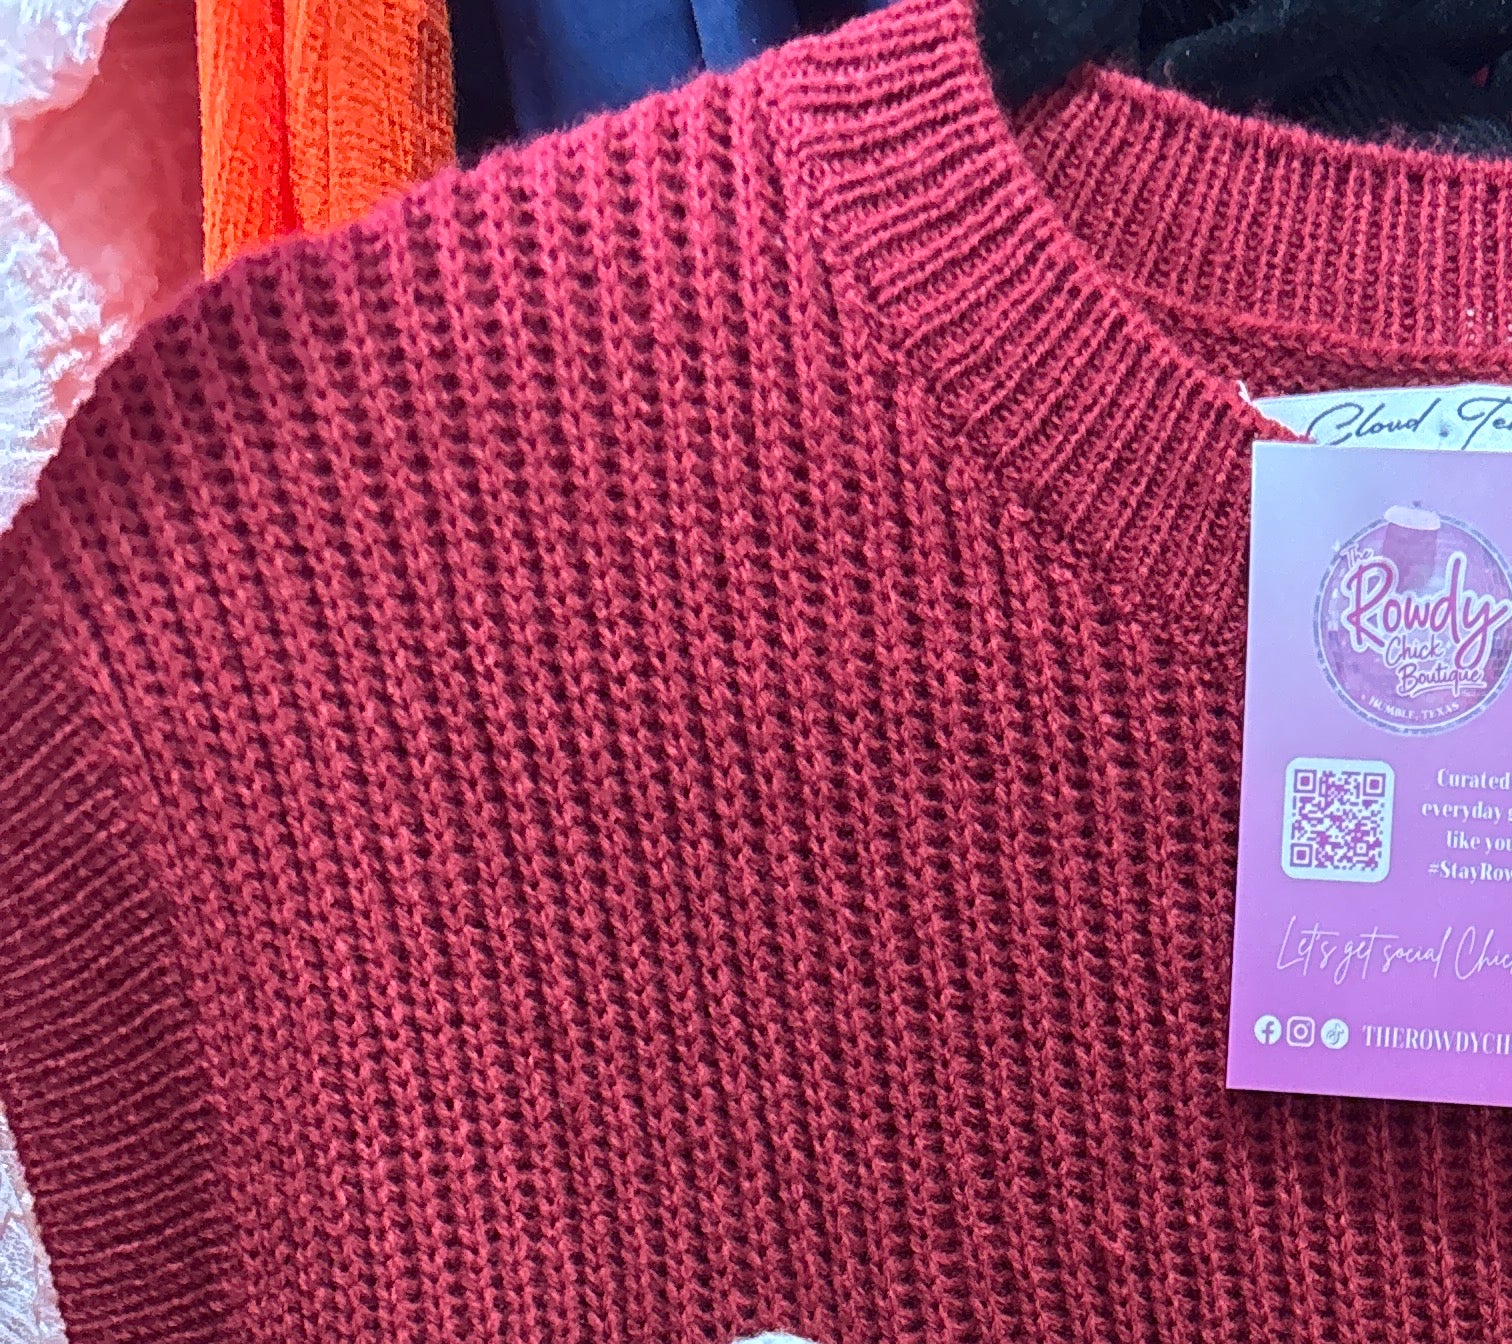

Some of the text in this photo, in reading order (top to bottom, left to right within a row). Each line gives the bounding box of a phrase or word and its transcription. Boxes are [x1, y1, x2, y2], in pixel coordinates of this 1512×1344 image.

[1307, 399, 1437, 443] Cloud
[1341, 546, 1374, 571] The
[1343, 554, 1511, 666] Rowdy
[1385, 637, 1443, 665] Chick
[1398, 663, 1485, 697] Boutique
[1437, 768, 1510, 791] Curated
[1422, 801, 1501, 822] everyday
[1446, 831, 1480, 850] like
[1276, 915, 1339, 976] Let's
[1334, 926, 1399, 985] get
[1384, 926, 1452, 976] social
